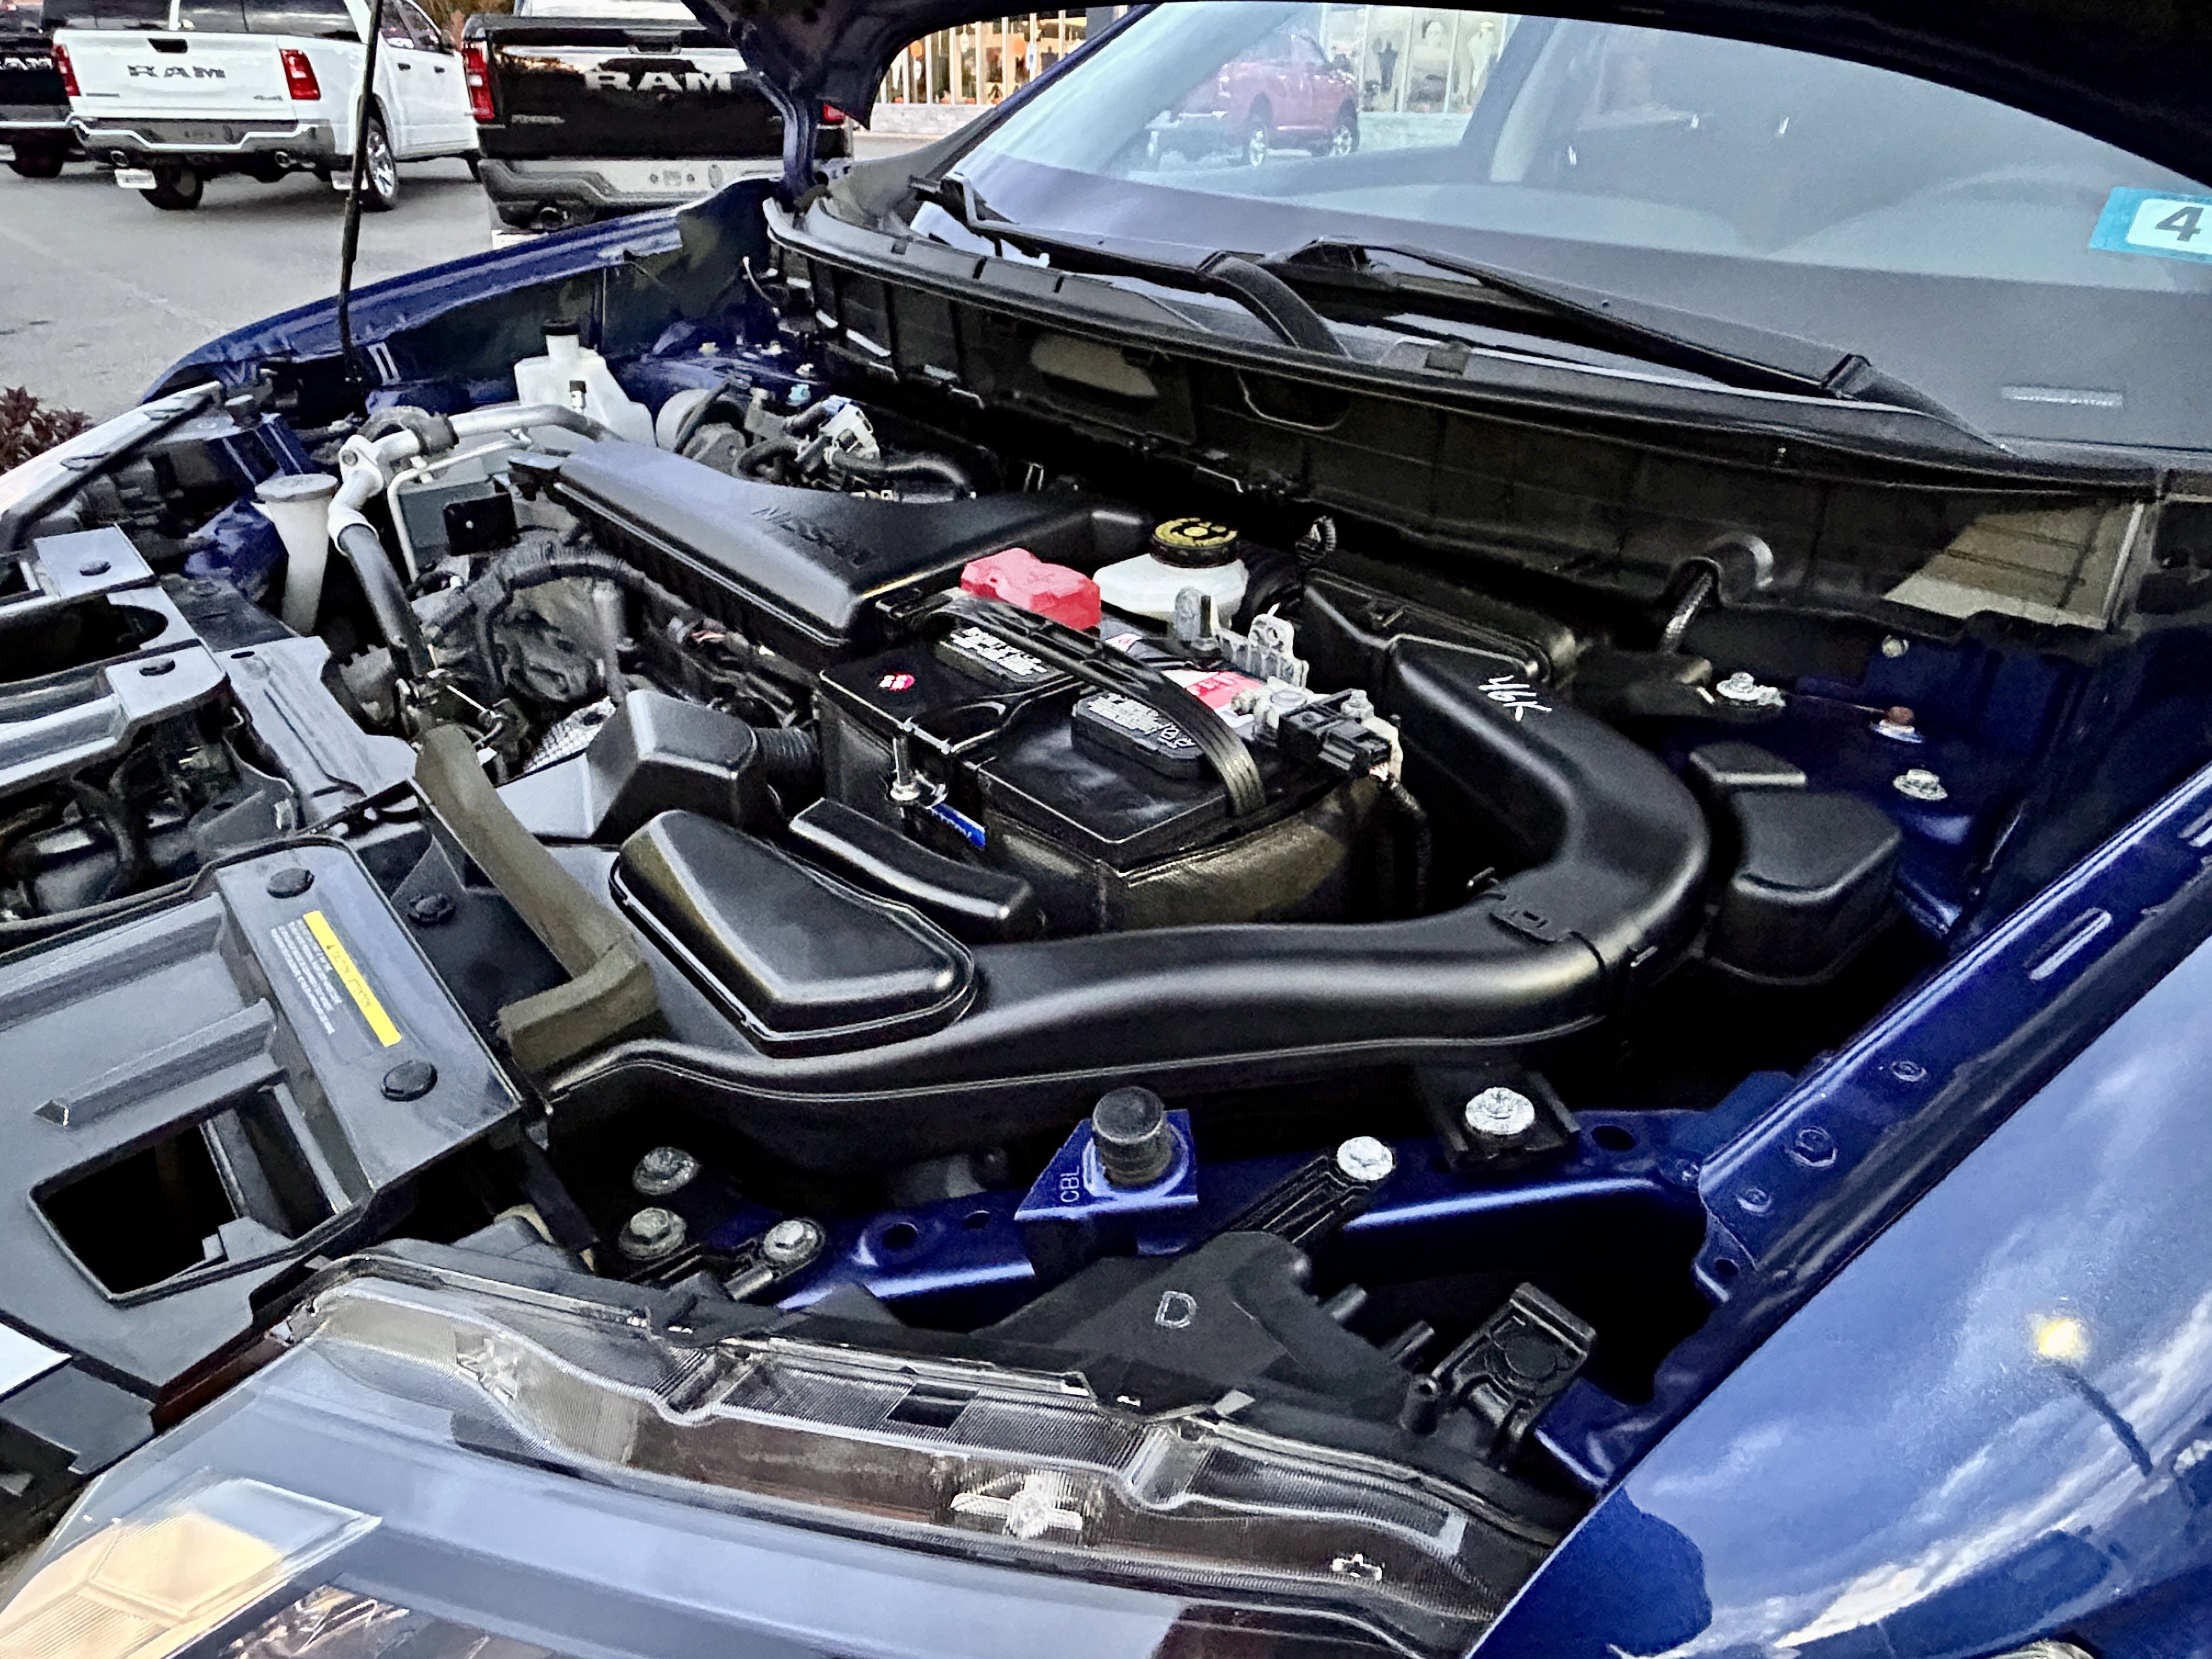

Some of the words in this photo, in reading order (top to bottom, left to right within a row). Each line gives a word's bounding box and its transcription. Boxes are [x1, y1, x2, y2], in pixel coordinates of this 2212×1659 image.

[0, 57, 53, 70] AM
[127, 65, 226, 78] RAM
[584, 70, 732, 92] RAM
[2155, 206, 2204, 242] 4
[1059, 1165, 1081, 1203] CBL
[1155, 1290, 1197, 1329] D
